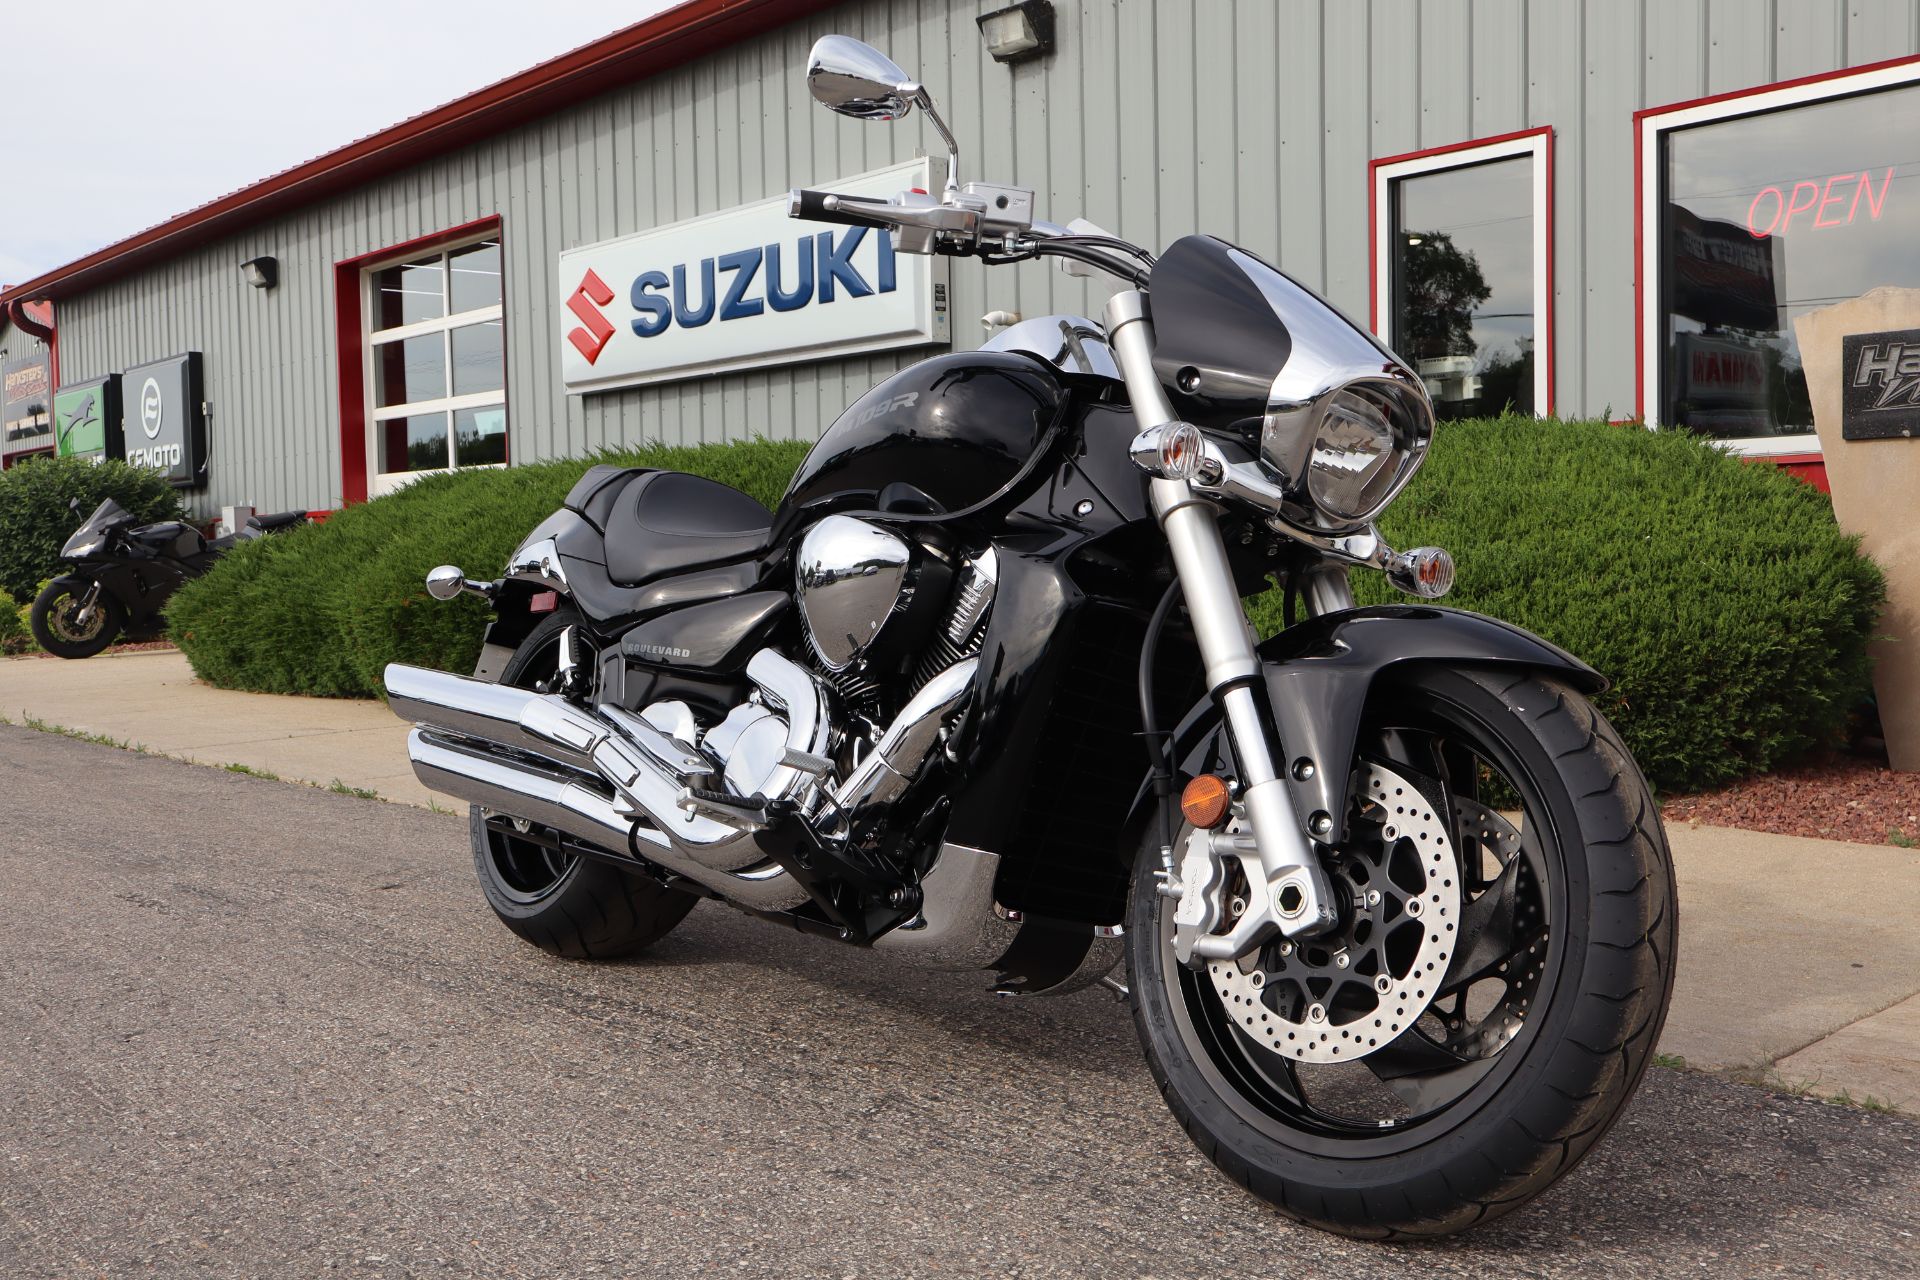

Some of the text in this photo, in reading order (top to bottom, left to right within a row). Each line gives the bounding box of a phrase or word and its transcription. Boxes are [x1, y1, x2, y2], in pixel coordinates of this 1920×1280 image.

[1748, 167, 1895, 238] OPEN
[630, 226, 897, 338] SUZUKI
[127, 443, 181, 469] CFMOTO
[627, 643, 690, 658] BOULEVARD
